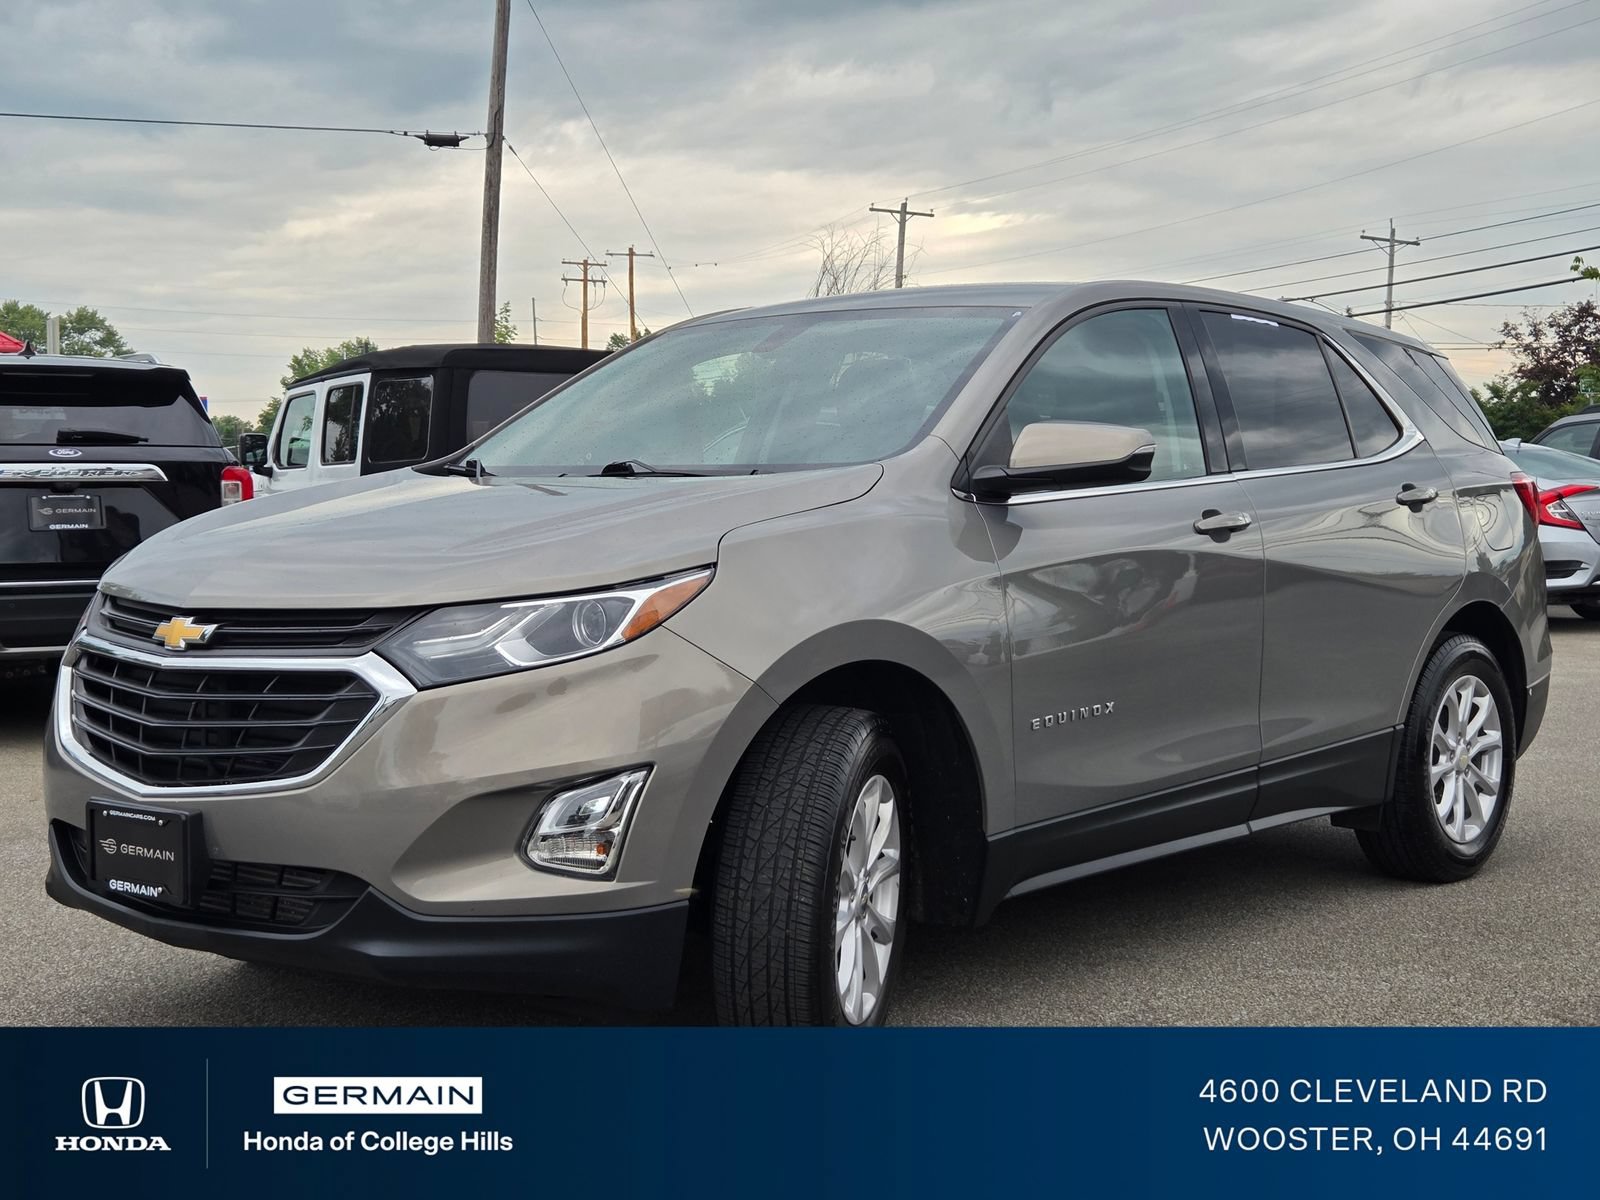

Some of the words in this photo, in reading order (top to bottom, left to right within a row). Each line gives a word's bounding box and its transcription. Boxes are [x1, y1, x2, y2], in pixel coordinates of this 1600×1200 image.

[1031, 701, 1115, 730] EQUINOX
[120, 843, 175, 862] GERMAIN
[109, 879, 158, 898] GERMAIN
